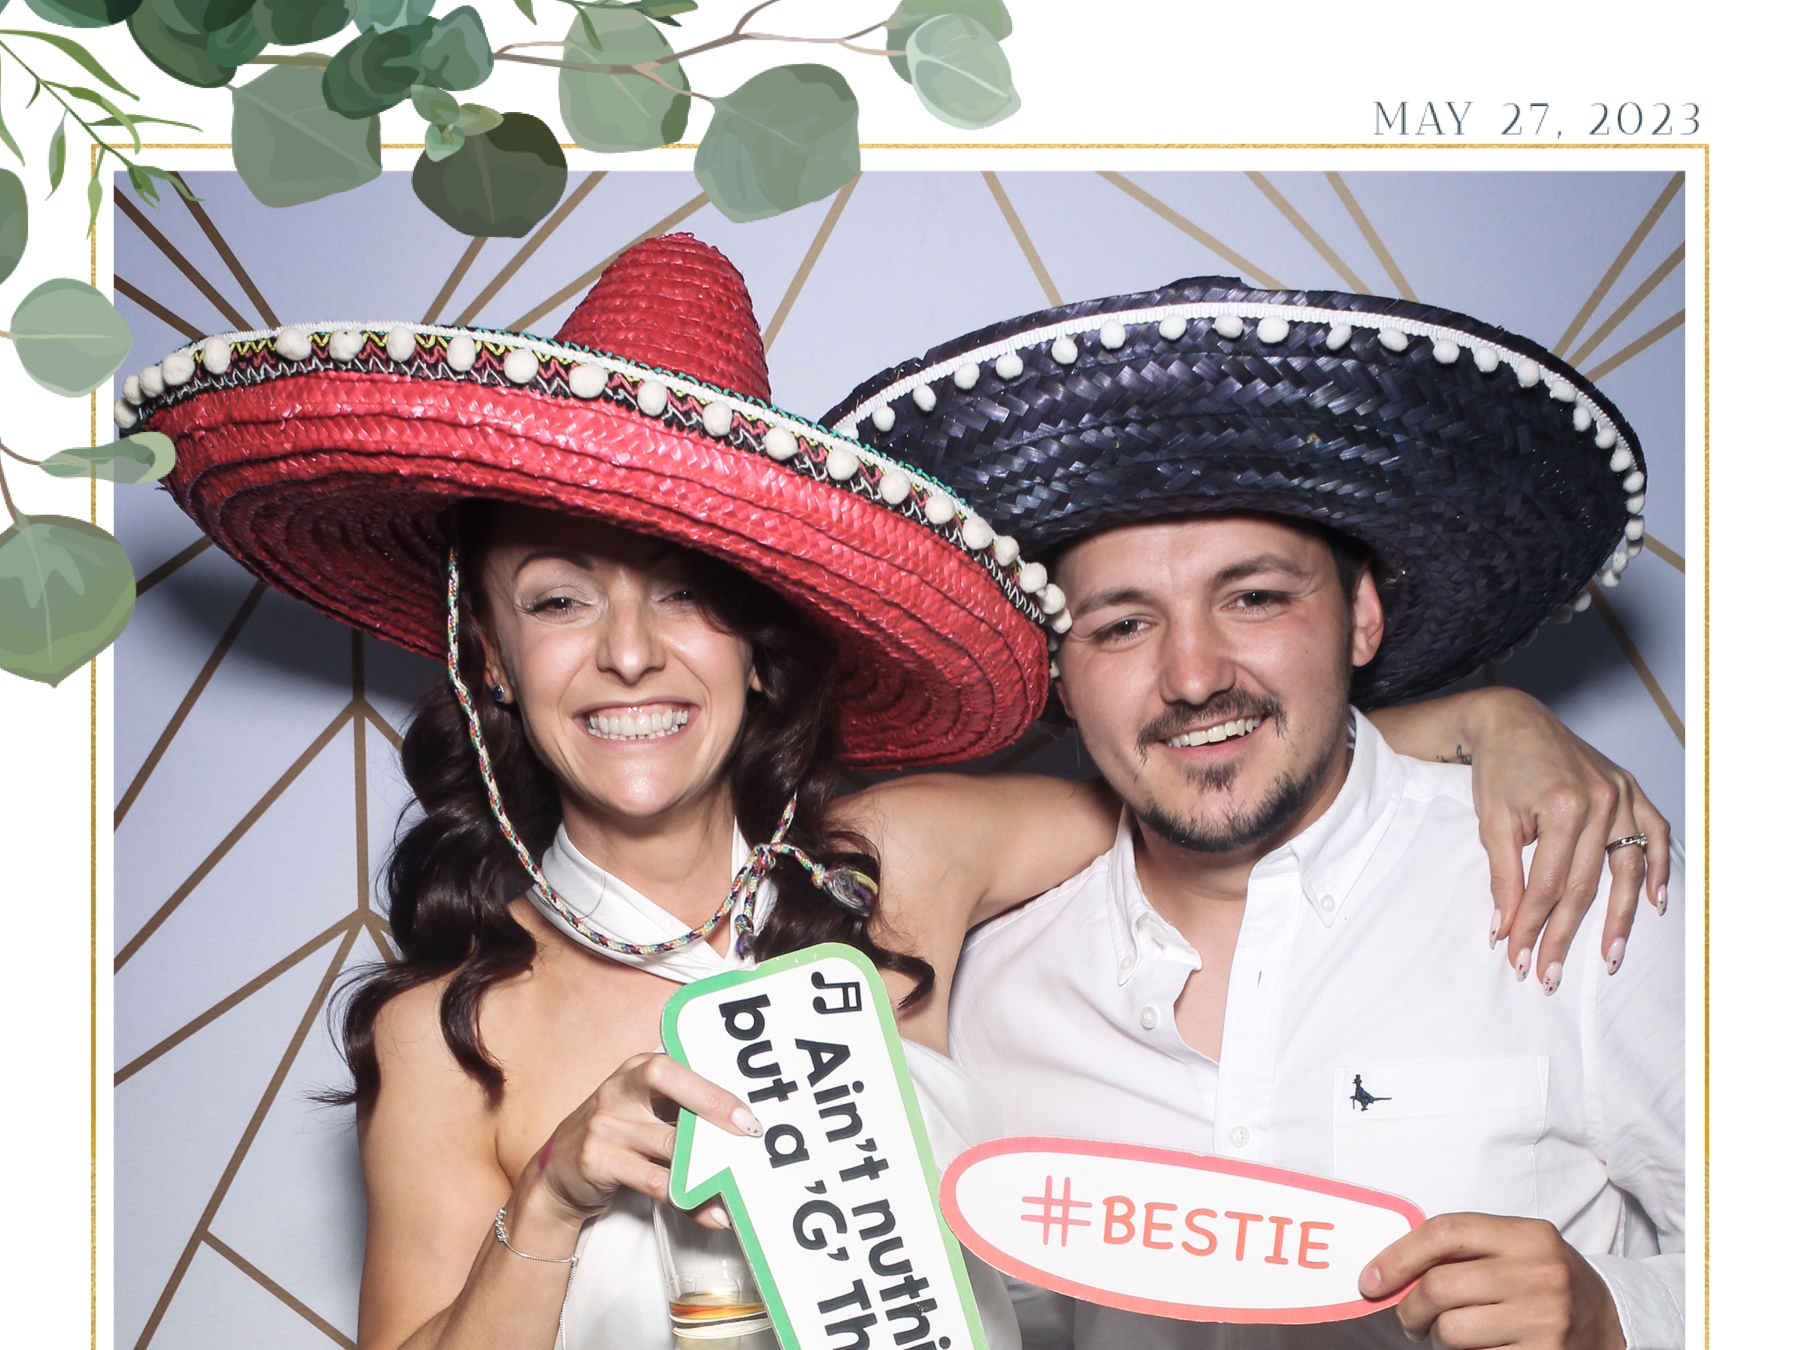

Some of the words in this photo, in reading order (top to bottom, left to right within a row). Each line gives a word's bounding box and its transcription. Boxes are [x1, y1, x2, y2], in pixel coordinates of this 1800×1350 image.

[718, 993, 799, 1105] but
[764, 1123, 810, 1168] a
[795, 1037, 889, 1182] Ain't
[1020, 1175, 1336, 1269] #BESTIE
